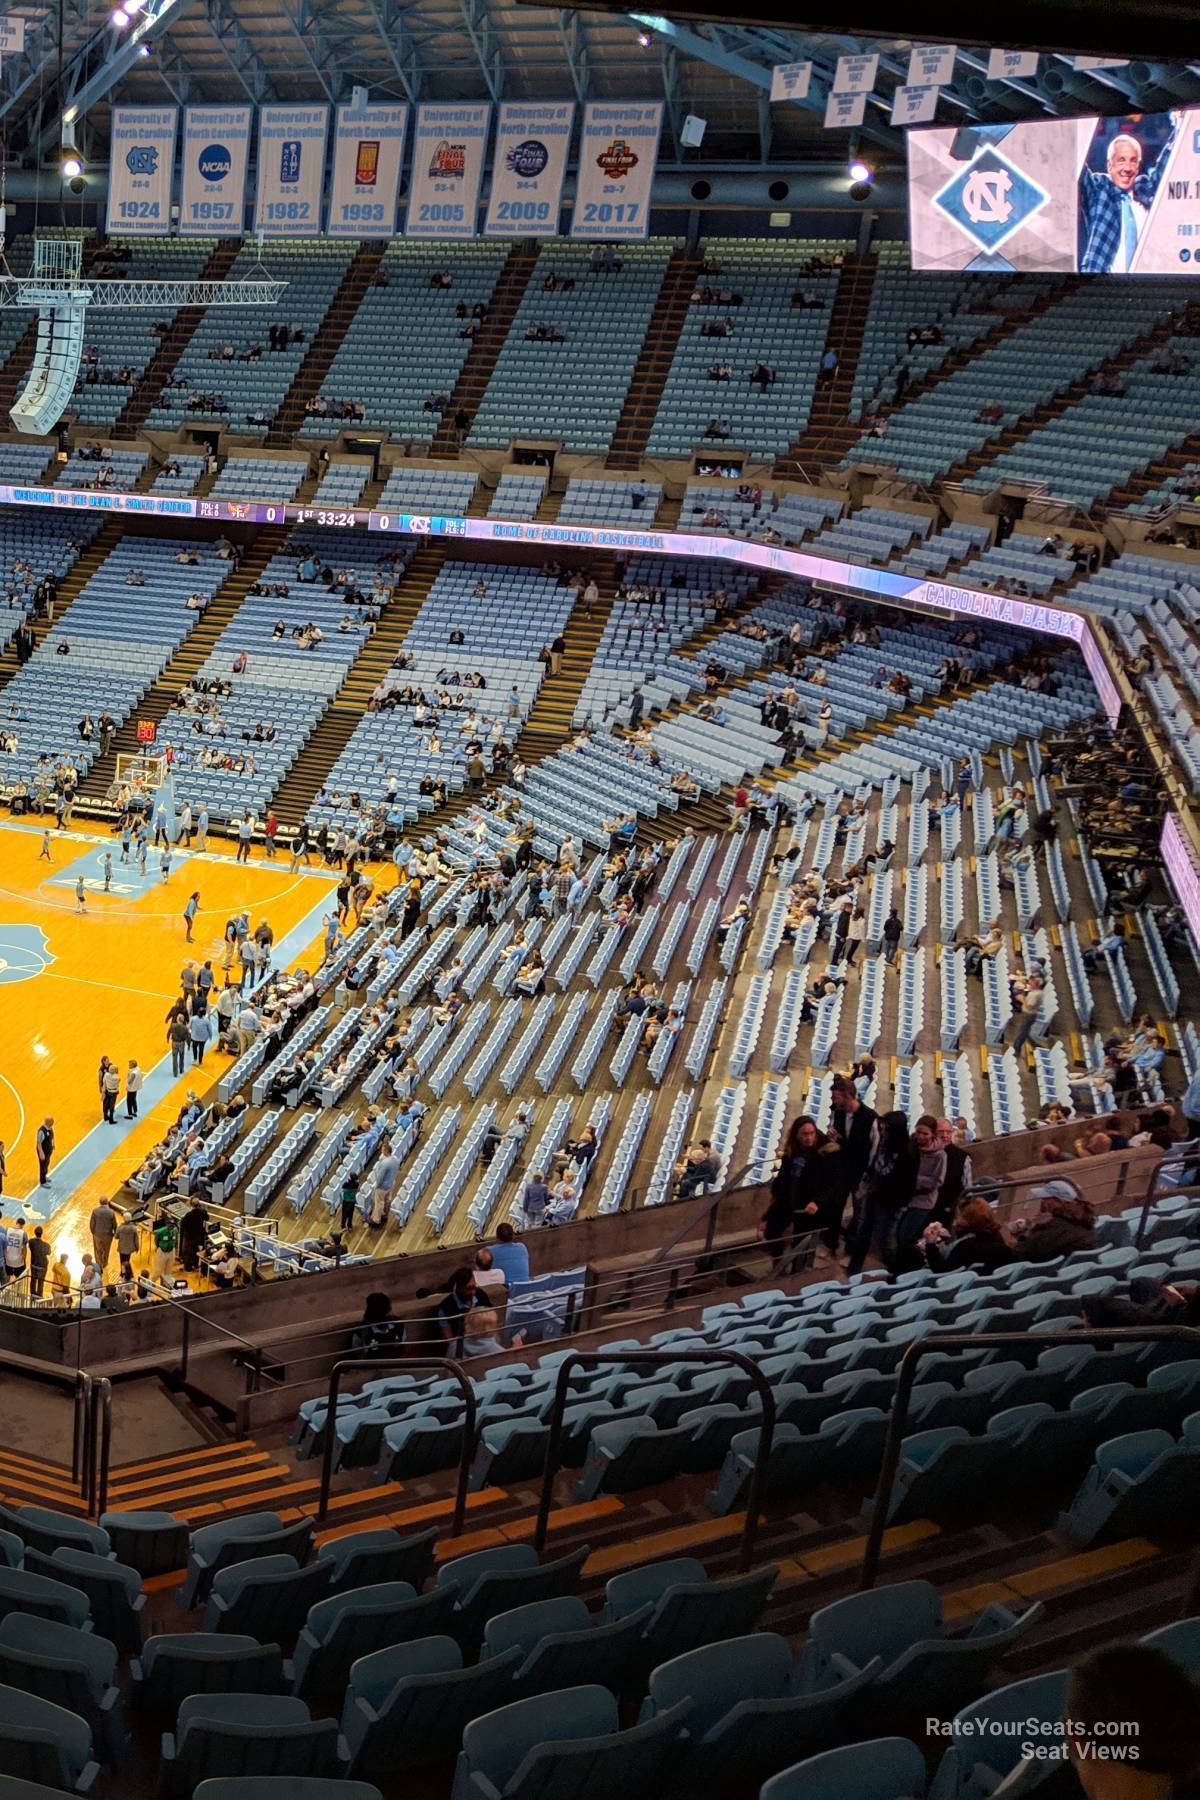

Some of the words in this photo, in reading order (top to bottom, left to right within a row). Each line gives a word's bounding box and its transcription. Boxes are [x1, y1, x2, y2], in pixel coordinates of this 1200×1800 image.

[115, 128, 138, 138] North
[187, 128, 209, 138] North
[262, 127, 285, 137] North
[339, 127, 363, 138] North
[418, 126, 444, 137] North
[501, 124, 526, 135] North
[586, 125, 613, 137] North
[437, 151, 465, 160] FINAL
[522, 148, 545, 158] FINAL
[201, 162, 230, 172] NCAA
[440, 160, 465, 169] FOUR
[515, 156, 544, 168] FOUR
[1167, 181, 1193, 200] NOV.
[118, 201, 160, 218] 1924
[191, 202, 234, 219] 1957
[266, 202, 310, 219] 1982
[341, 203, 385, 220] 1993
[419, 204, 465, 221] 2005
[497, 201, 550, 220] 2009
[583, 203, 639, 222] 2017
[14, 489, 55, 503] WELCOME
[70, 493, 87, 506] THE
[90, 495, 112, 507] DEAN
[125, 498, 155, 511] SMITH
[158, 500, 192, 513] CENTER
[200, 502, 214, 510] TOL:
[267, 508, 276, 521] 0
[297, 510, 314, 523] 1ST
[317, 511, 355, 526] 33:24
[380, 515, 389, 529] 0
[445, 520, 460, 528] TOL:
[493, 524, 522, 538] HOME
[527, 527, 539, 538] OF
[542, 528, 594, 543] CAROLINA
[598, 532, 665, 549] BASKETBALL
[926, 584, 1014, 622] CAROLINA
[140, 727, 152, 739] 30
[7, 1238, 21, 1248] 52
